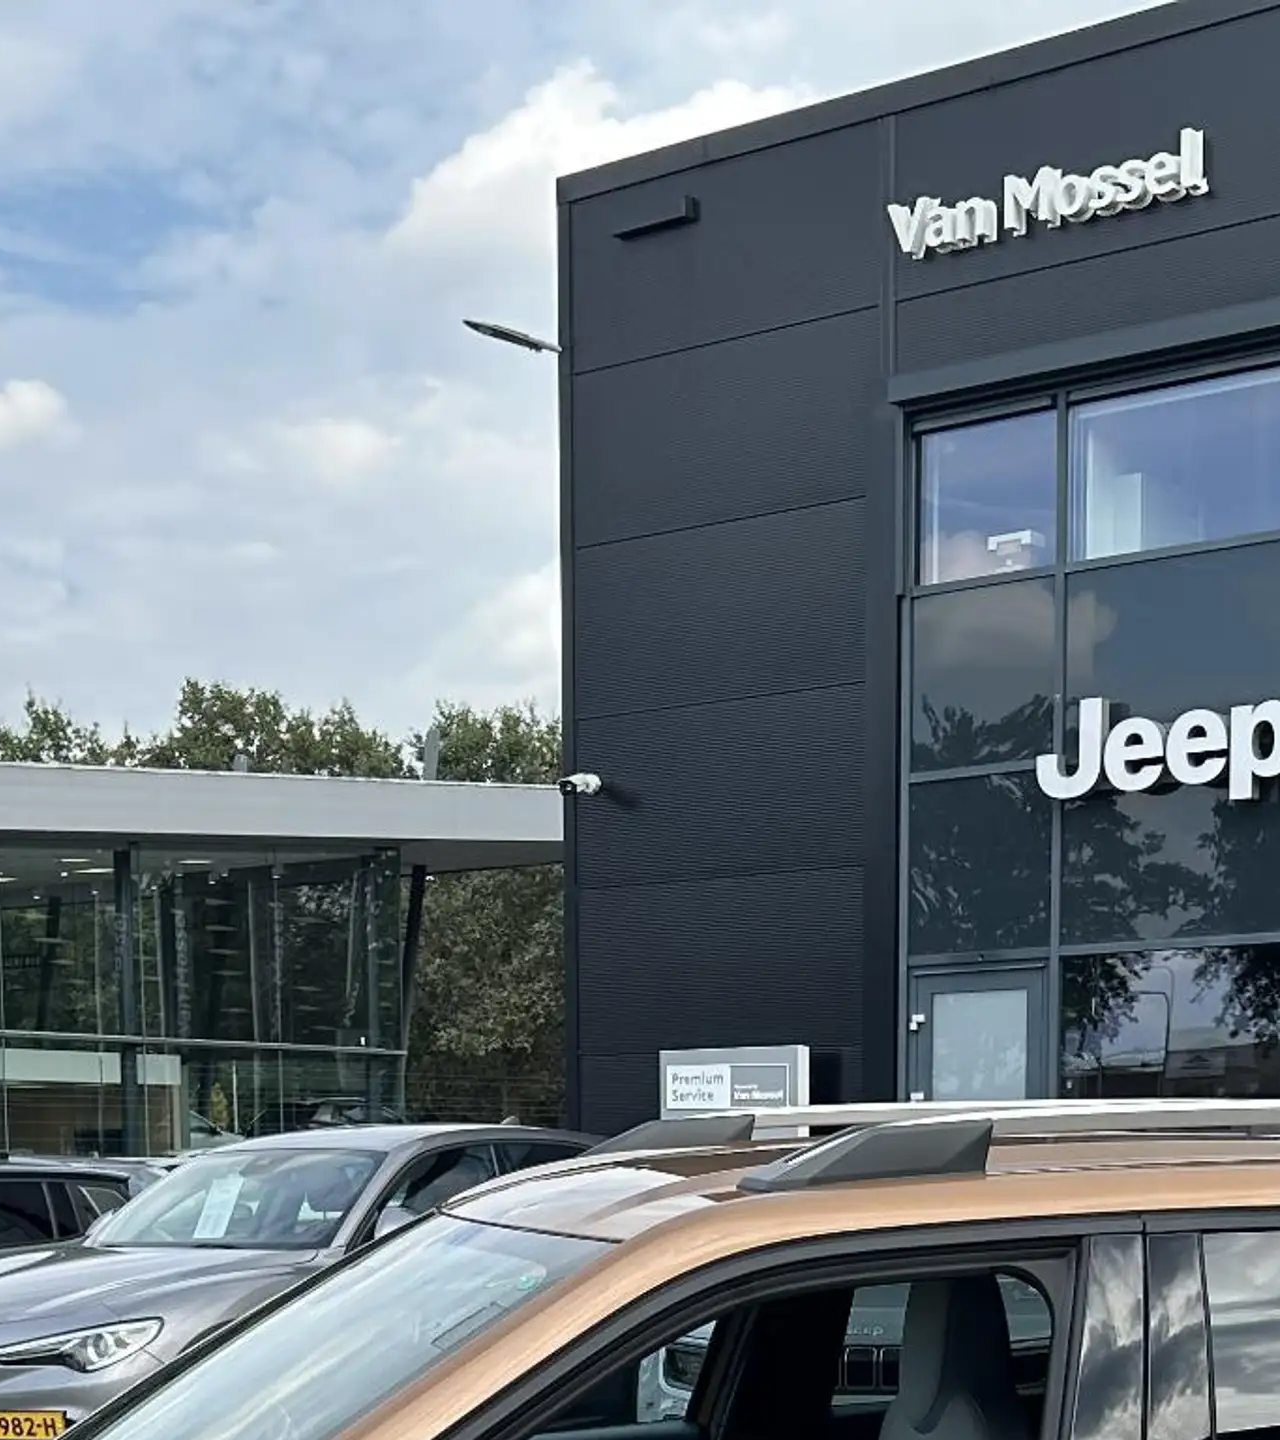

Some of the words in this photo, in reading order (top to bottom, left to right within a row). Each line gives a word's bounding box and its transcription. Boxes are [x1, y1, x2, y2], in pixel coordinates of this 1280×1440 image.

[888, 197, 998, 260] Van
[1004, 127, 1209, 237] Mossel
[672, 1071, 724, 1086] Premium
[672, 1088, 715, 1102] Service
